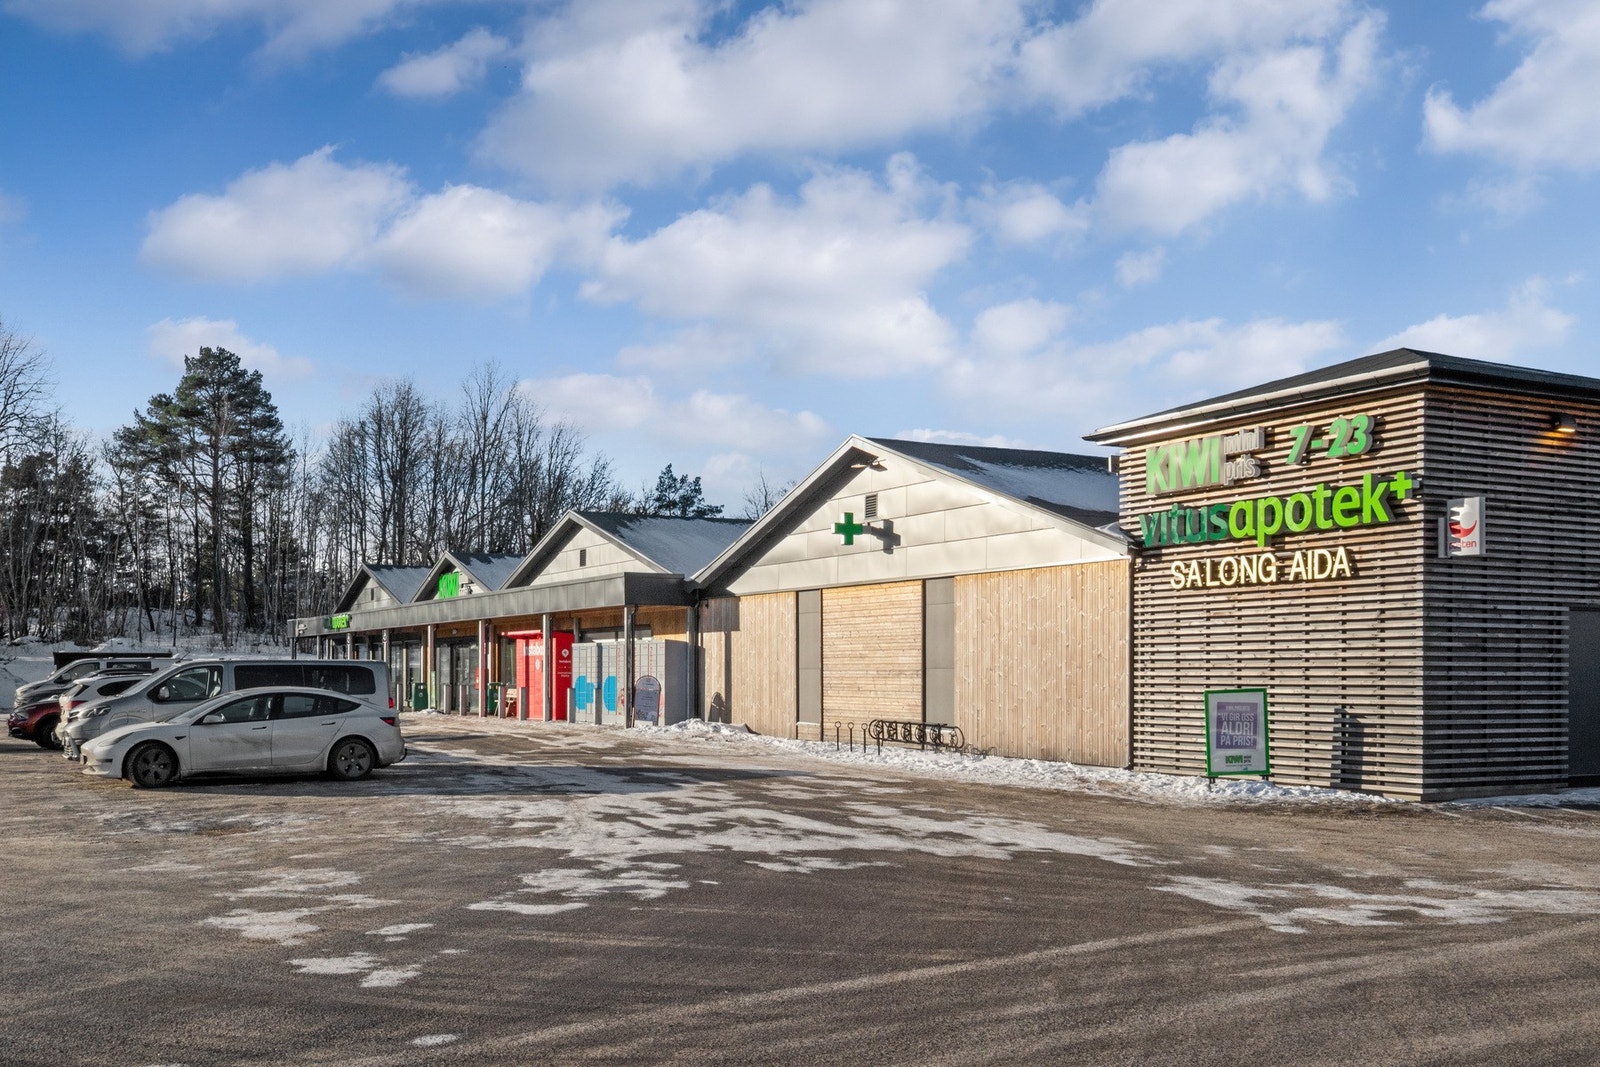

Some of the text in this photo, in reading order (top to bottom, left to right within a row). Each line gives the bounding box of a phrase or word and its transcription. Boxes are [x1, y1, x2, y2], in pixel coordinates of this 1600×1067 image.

[1286, 414, 1371, 465] 7-23
[1146, 436, 1221, 495] KIWI
[1223, 454, 1258, 487] pris
[1170, 545, 1352, 590] SALONG AIDA
[1221, 721, 1254, 735] ALDRI
